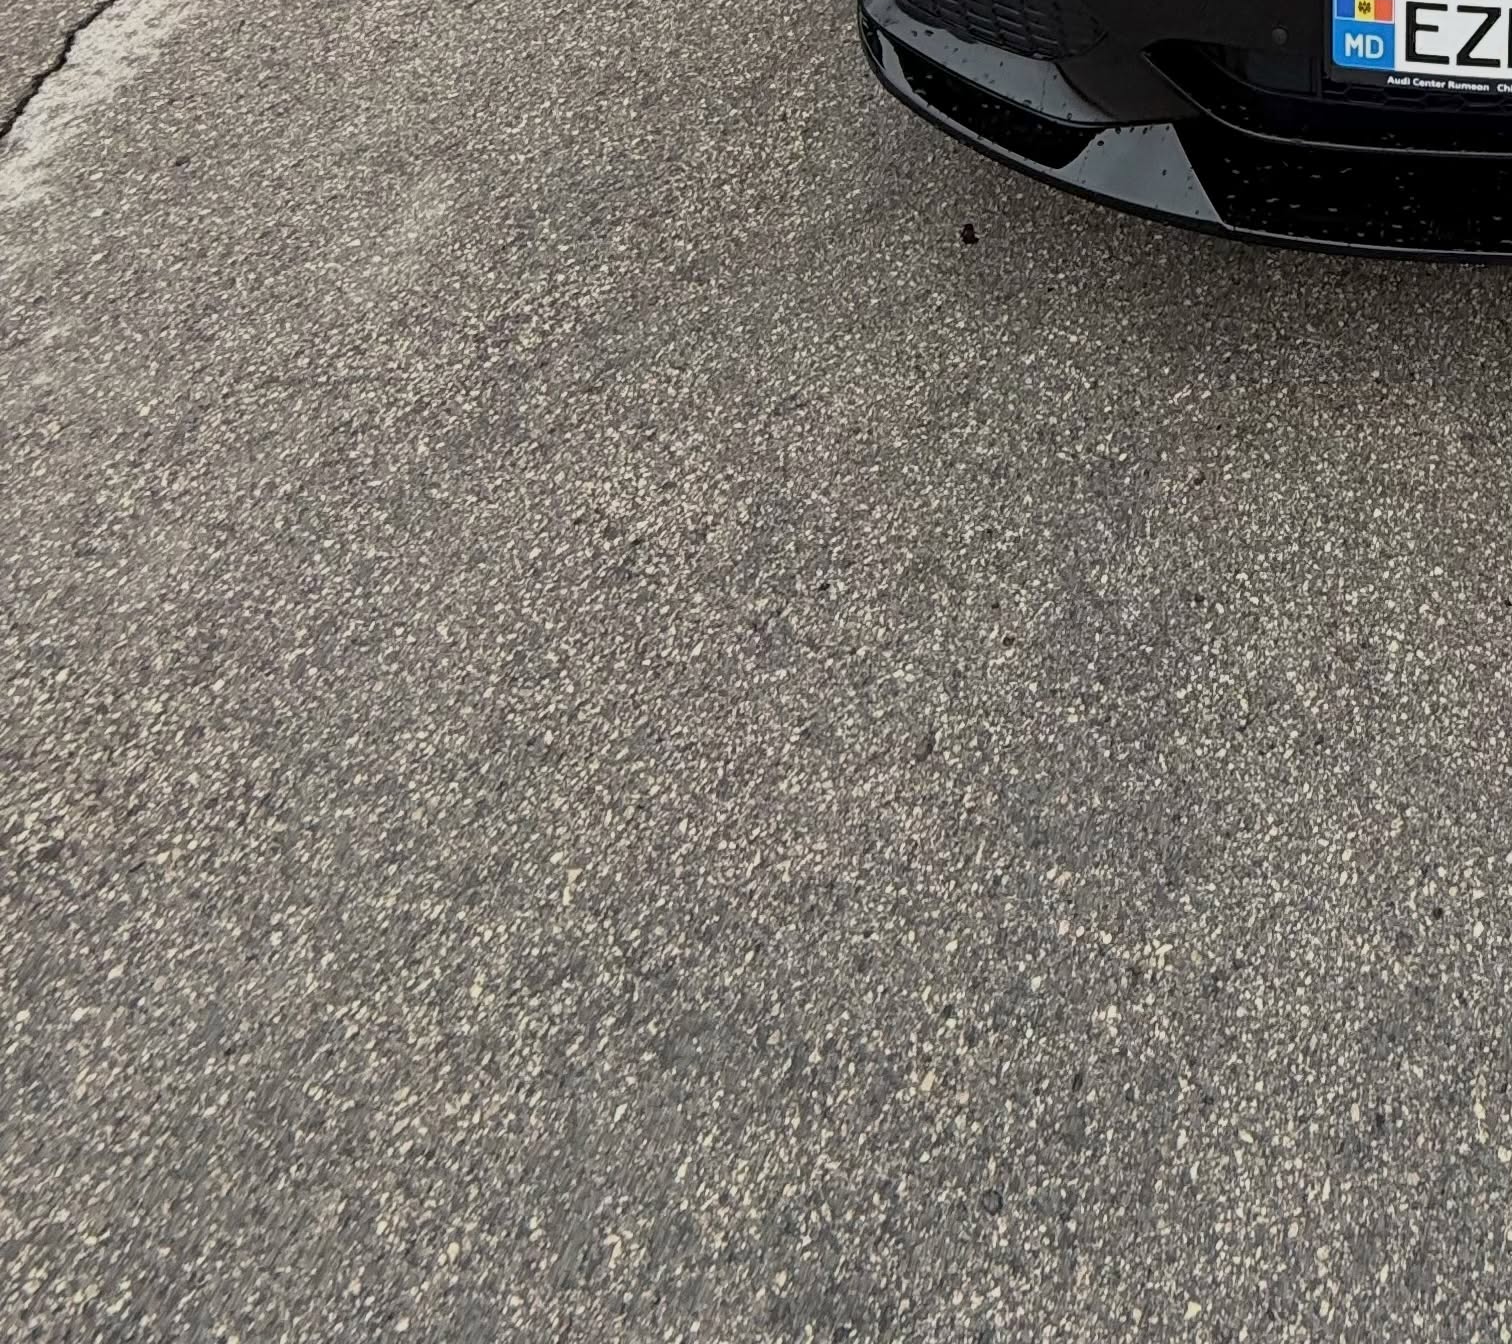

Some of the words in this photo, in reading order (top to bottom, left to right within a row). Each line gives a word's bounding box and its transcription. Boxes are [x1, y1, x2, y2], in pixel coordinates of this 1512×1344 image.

[1344, 32, 1384, 59] MD
[1387, 75, 1411, 86] Audi
[1412, 78, 1446, 89] Center
